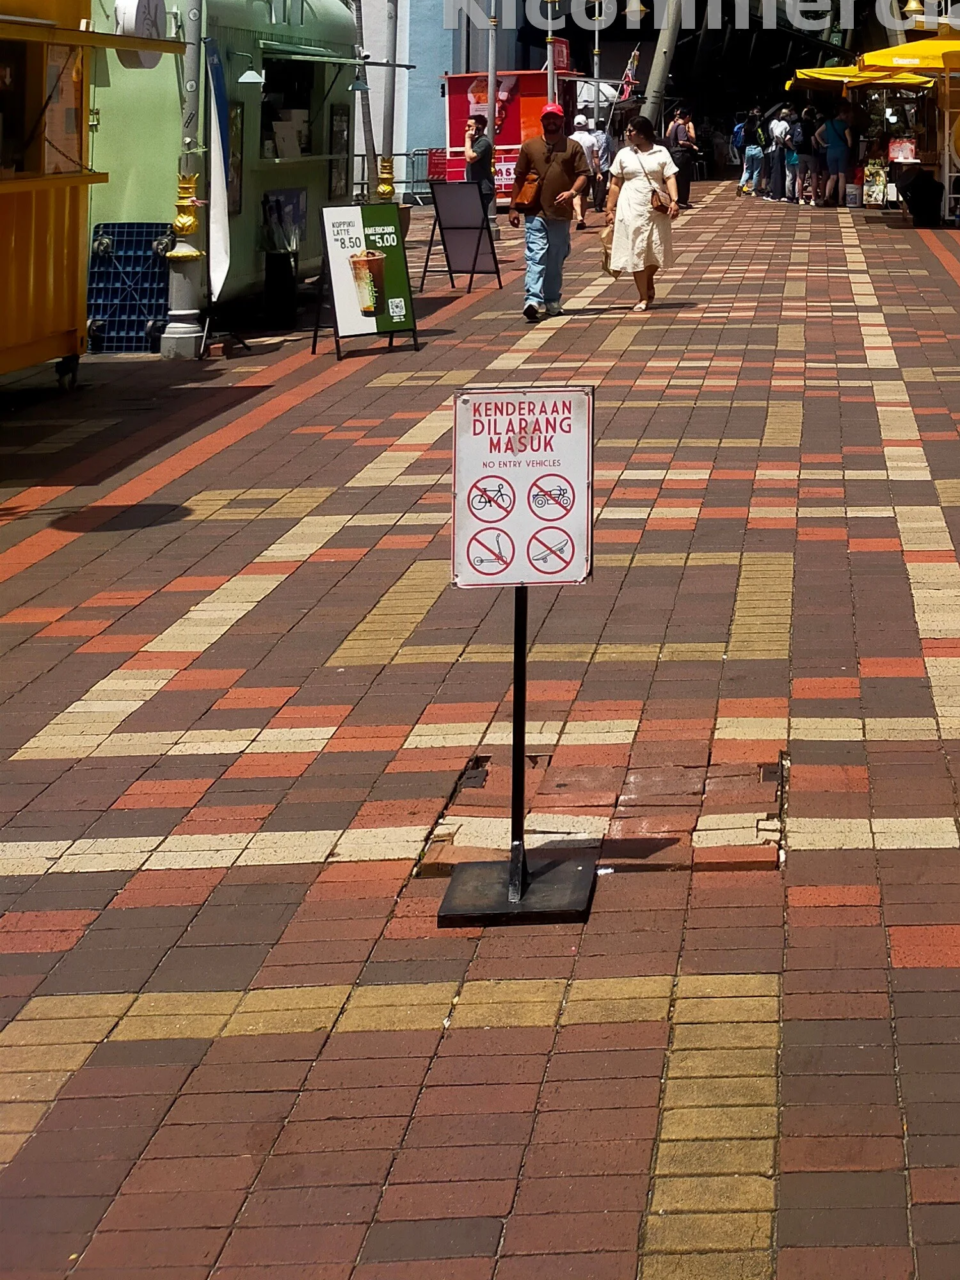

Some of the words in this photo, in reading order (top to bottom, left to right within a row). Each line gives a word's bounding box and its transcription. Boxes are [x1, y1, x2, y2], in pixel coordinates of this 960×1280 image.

[331, 220, 356, 229] KOPPIKU
[364, 225, 396, 235] AMERICANO
[332, 228, 351, 237] LATTE
[340, 236, 362, 250] 8.50
[375, 234, 397, 247] 5.00
[473, 400, 572, 418] KENDERAAN
[472, 417, 572, 436] DILARANG
[489, 435, 555, 454] MASUK
[482, 460, 496, 469] NO
[498, 460, 522, 468] ENTRY
[526, 459, 562, 468] VEHICLES
